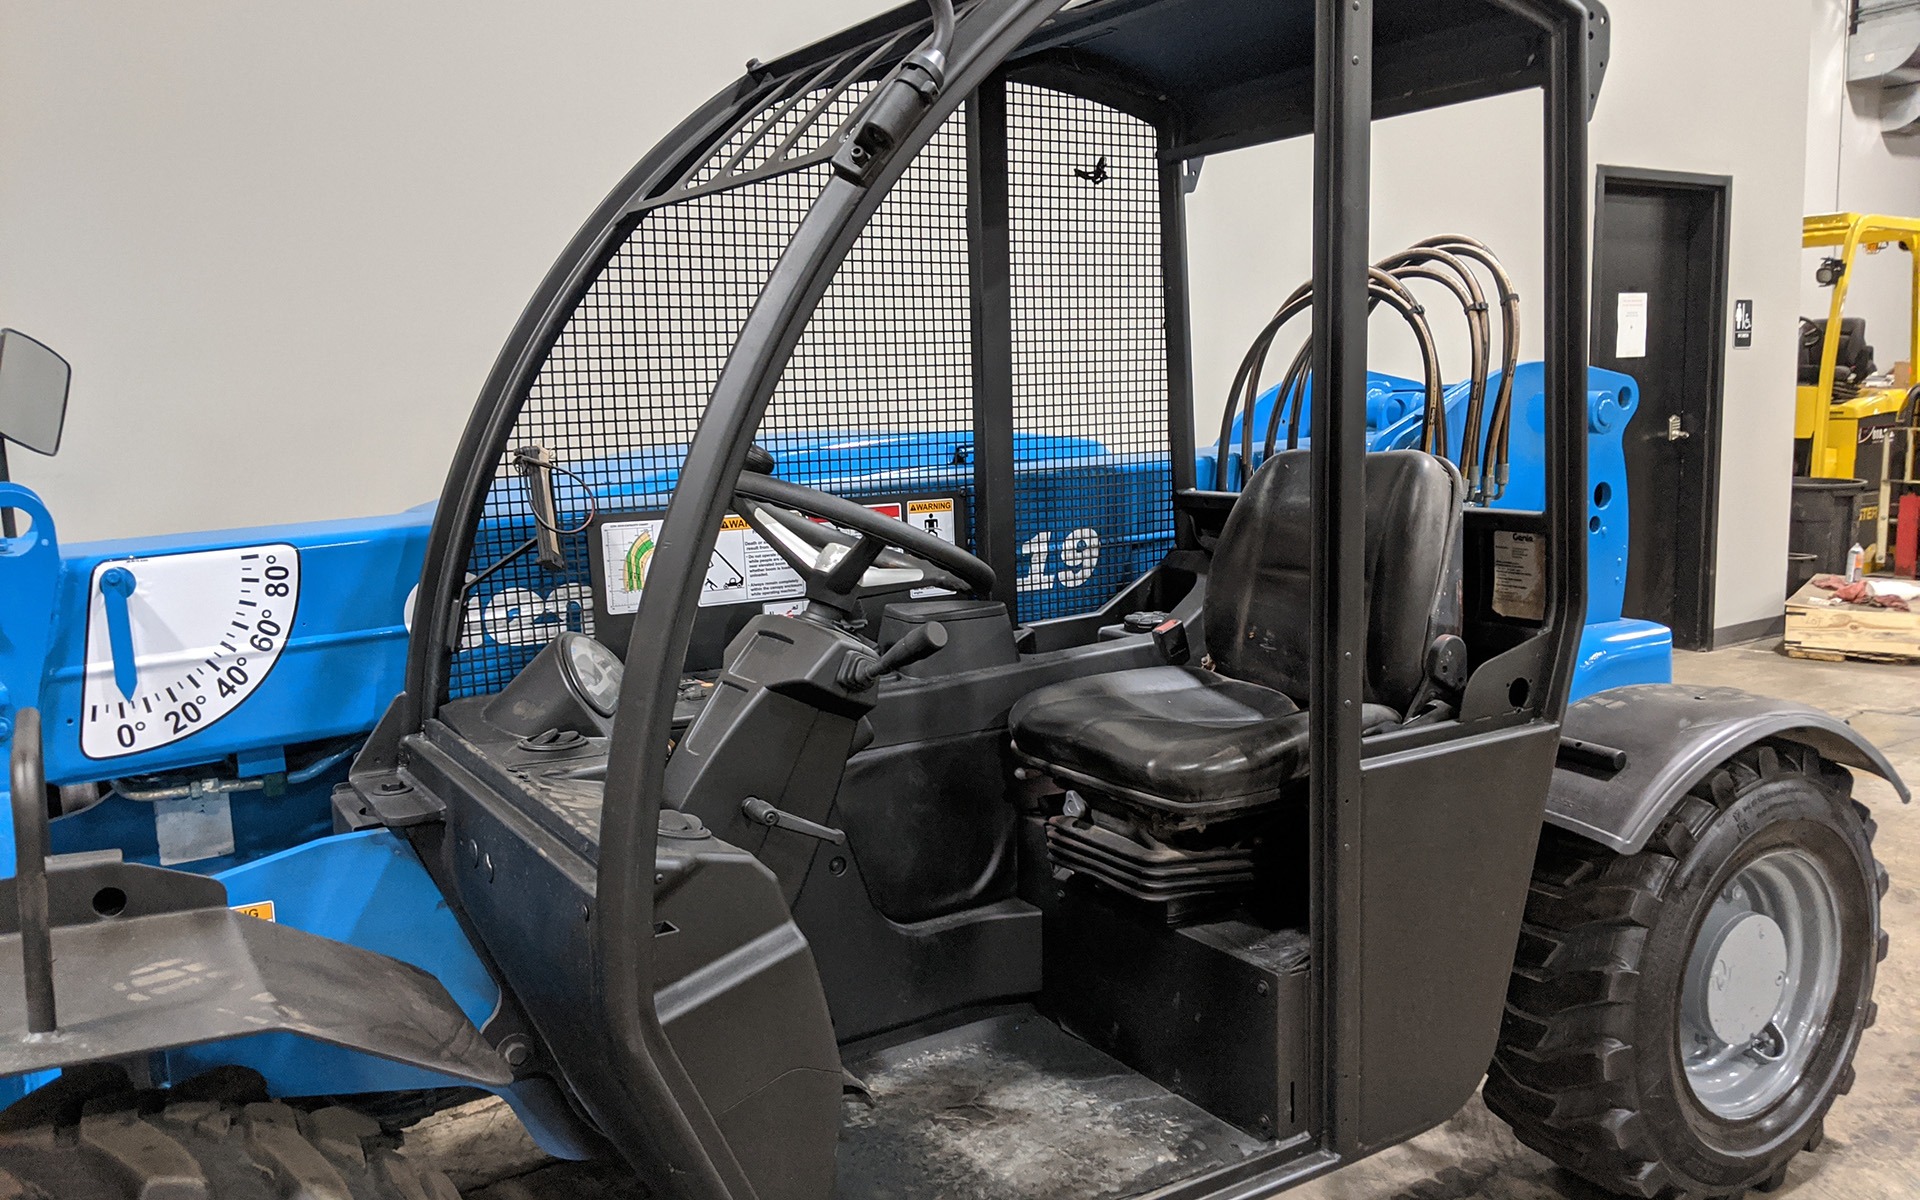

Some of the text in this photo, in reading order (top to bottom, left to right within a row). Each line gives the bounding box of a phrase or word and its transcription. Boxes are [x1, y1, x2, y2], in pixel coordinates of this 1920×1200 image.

[916, 502, 951, 511] WARNING
[1512, 532, 1535, 542] Genie
[264, 555, 290, 598] 80°
[1016, 528, 1101, 592] 19
[249, 609, 281, 652] 60°
[216, 657, 249, 699] 40°
[116, 721, 146, 748] 0°
[163, 695, 207, 735] 20°
